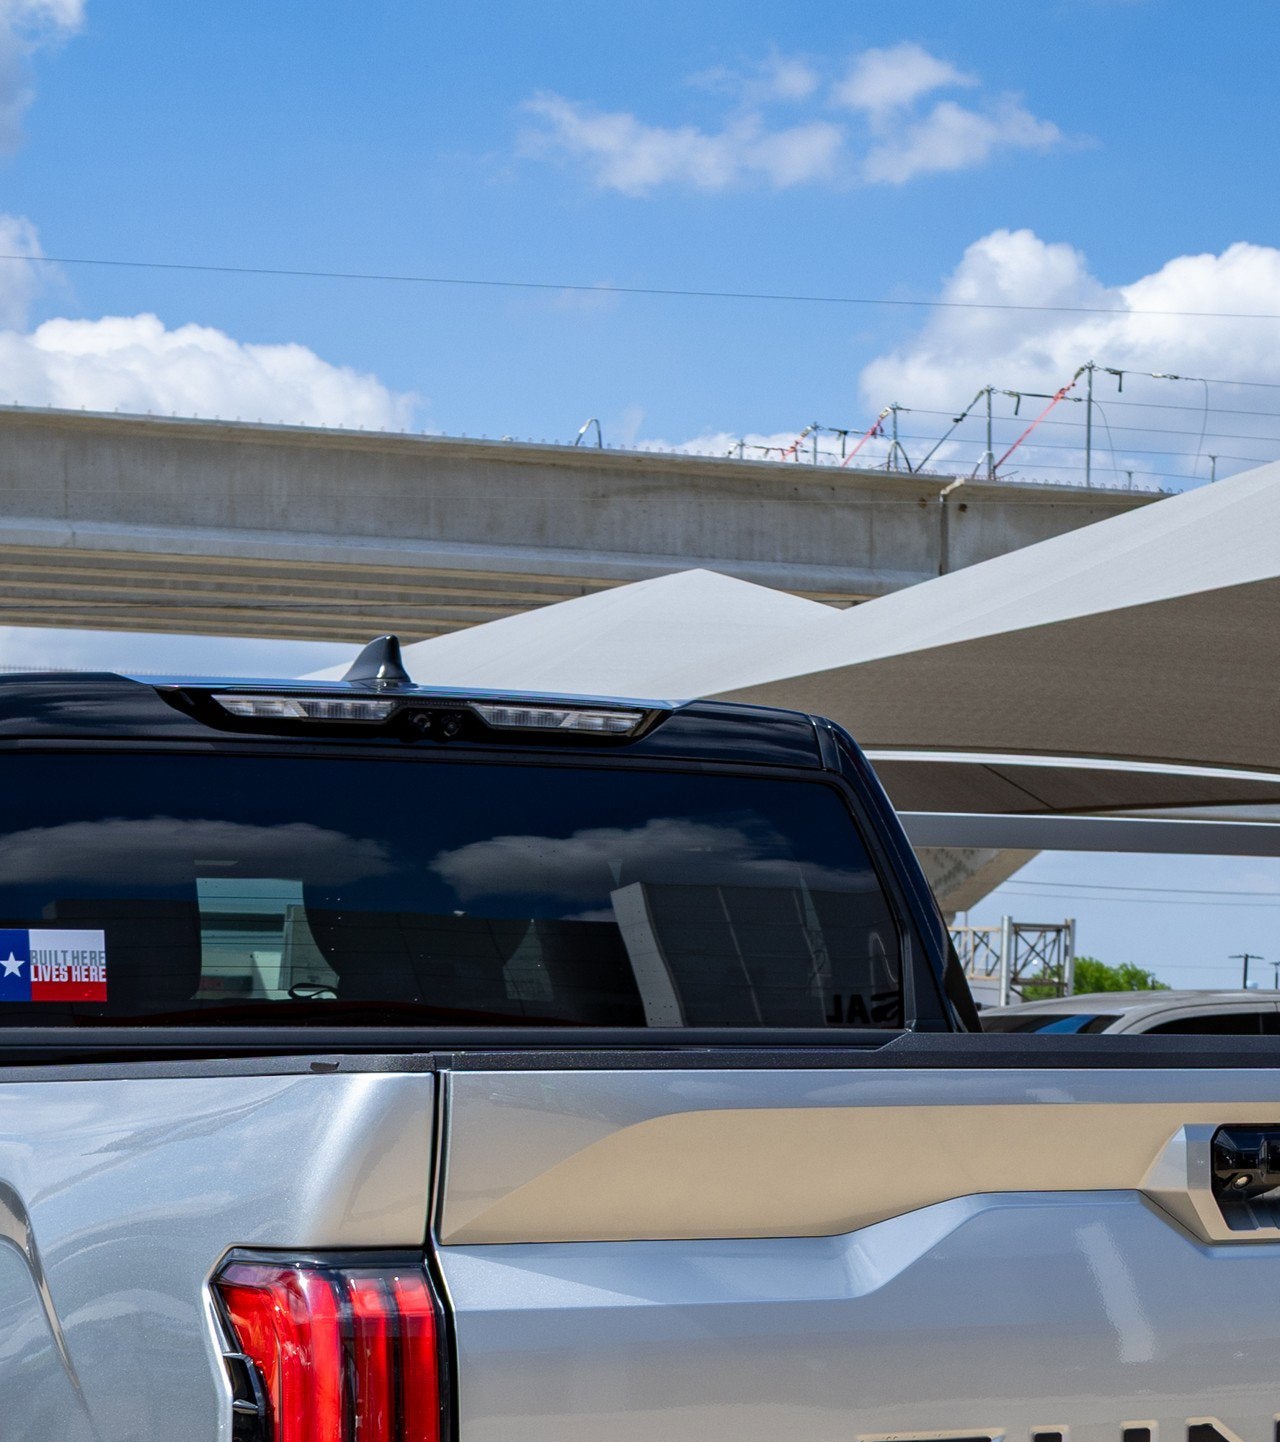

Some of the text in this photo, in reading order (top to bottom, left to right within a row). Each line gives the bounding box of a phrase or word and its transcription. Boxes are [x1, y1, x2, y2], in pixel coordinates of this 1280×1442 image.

[30, 950, 106, 966] BUILT HERE
[30, 965, 107, 982] LIVES HERE
